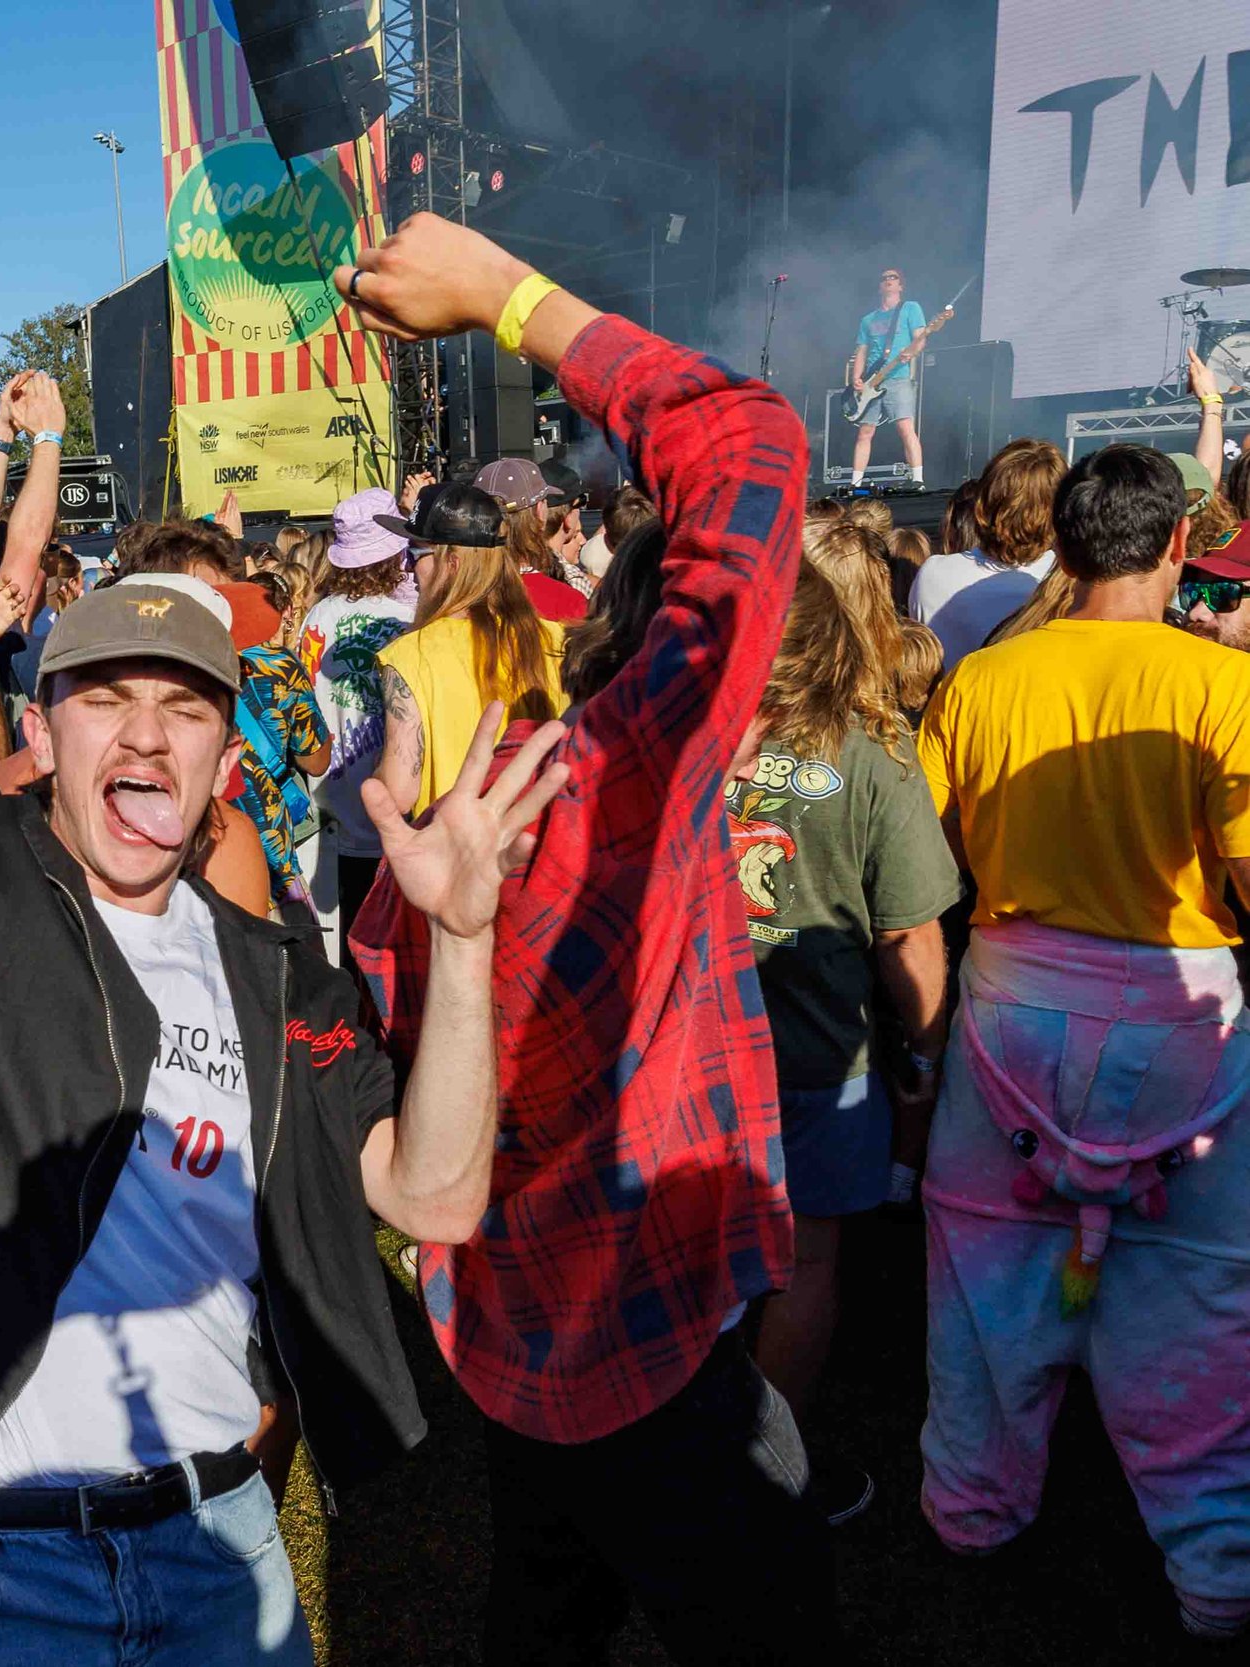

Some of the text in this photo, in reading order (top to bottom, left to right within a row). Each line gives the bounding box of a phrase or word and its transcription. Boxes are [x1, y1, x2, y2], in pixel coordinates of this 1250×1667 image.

[177, 270, 236, 335] PRODUCT
[242, 325, 262, 341] OF
[236, 424, 310, 440] feel new south wales
[200, 440, 218, 450] NSW
[214, 465, 258, 484] LISMORE
[67, 488, 84, 503] IJS
[757, 924, 775, 935] YOU
[777, 930, 795, 938] EAT
[173, 1023, 209, 1052] TO
[208, 1061, 242, 1090] MY
[171, 1115, 225, 1179] 10
